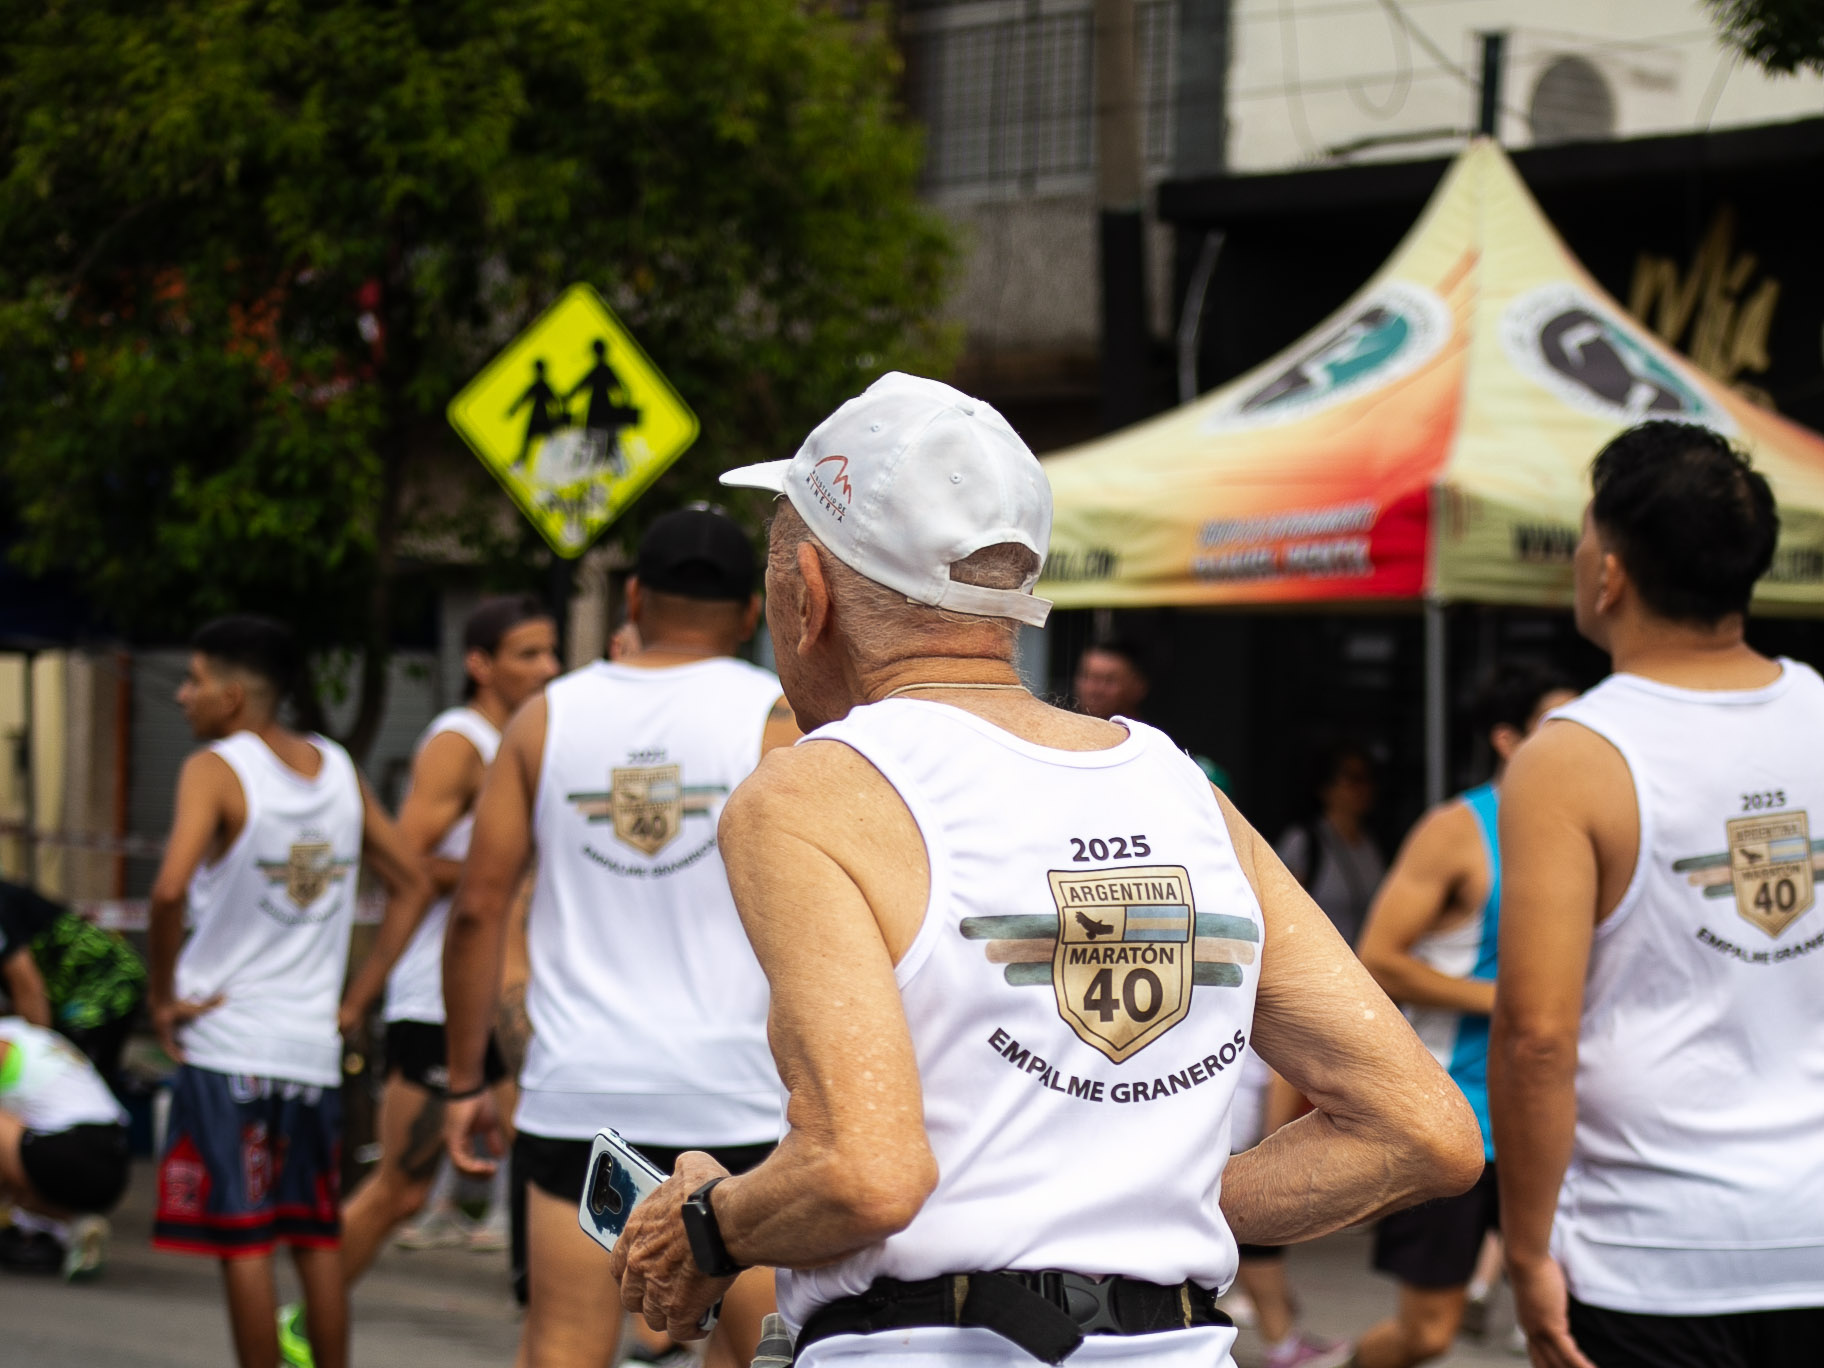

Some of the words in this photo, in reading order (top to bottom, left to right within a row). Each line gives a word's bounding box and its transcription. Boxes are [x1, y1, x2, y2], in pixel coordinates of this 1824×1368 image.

[1741, 791, 1786, 811] 2025
[1070, 835, 1151, 862] 2025
[1068, 881, 1178, 902] ARGENTINA
[1754, 878, 1797, 914] 40
[1069, 944, 1175, 966] MARATÓN
[1083, 967, 1163, 1023] 40
[987, 1027, 1104, 1103] EMPALME
[1110, 1029, 1247, 1103] GRANEROS
